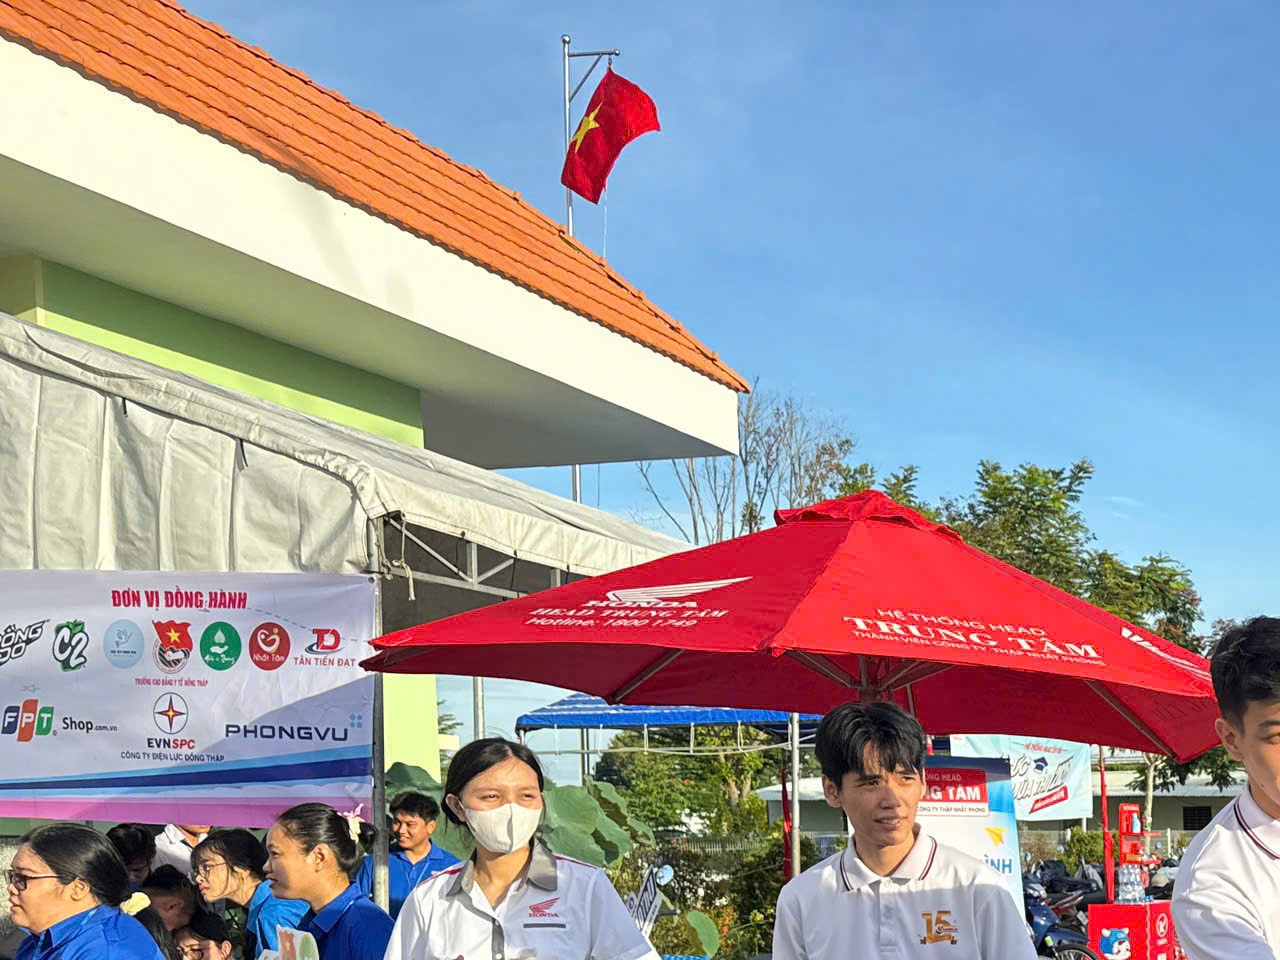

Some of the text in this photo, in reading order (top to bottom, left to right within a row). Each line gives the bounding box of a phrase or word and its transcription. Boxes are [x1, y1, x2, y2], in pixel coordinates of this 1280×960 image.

[111, 585, 249, 612] ĐƠN VỊ ĐỒNG HÀNH
[582, 600, 698, 608] HONDA
[529, 608, 596, 617] HEAD
[600, 609, 677, 618] TRUNG
[525, 617, 600, 627] Hotline:
[603, 618, 650, 628] 1800
[988, 623, 1046, 637] HEAD
[842, 616, 1103, 659] TRUNG TÂM
[53, 626, 90, 670] C2
[225, 723, 348, 742] PHONGVU
[146, 737, 196, 750] EVNSPC
[120, 750, 141, 760] CÔNG
[942, 773, 961, 782] HEAD
